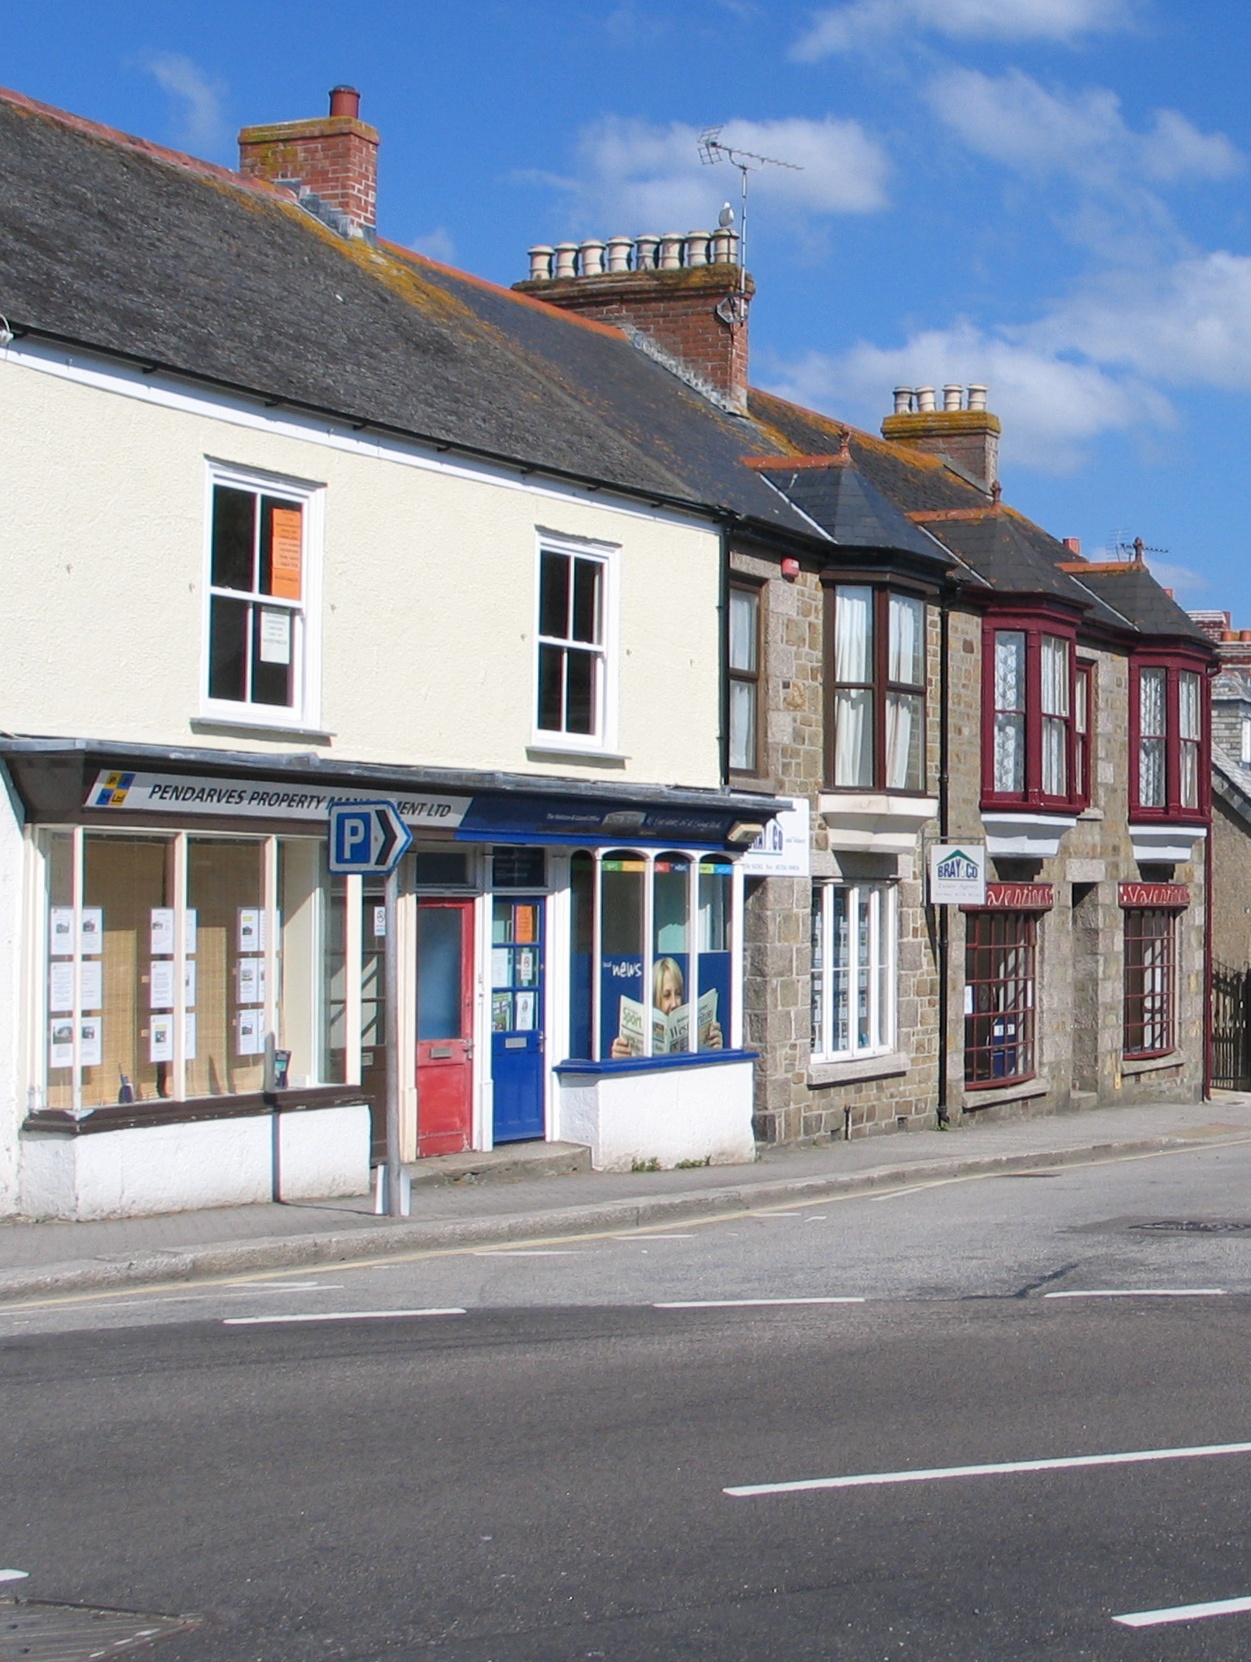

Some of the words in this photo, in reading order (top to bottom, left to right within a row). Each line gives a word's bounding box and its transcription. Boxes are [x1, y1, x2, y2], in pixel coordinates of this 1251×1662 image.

[149, 784, 247, 805] PENDARVES
[248, 790, 326, 809] PROPERTY
[426, 803, 452, 818] LTD
[344, 818, 365, 860] P
[987, 886, 1051, 906] alentines
[612, 961, 643, 978] news
